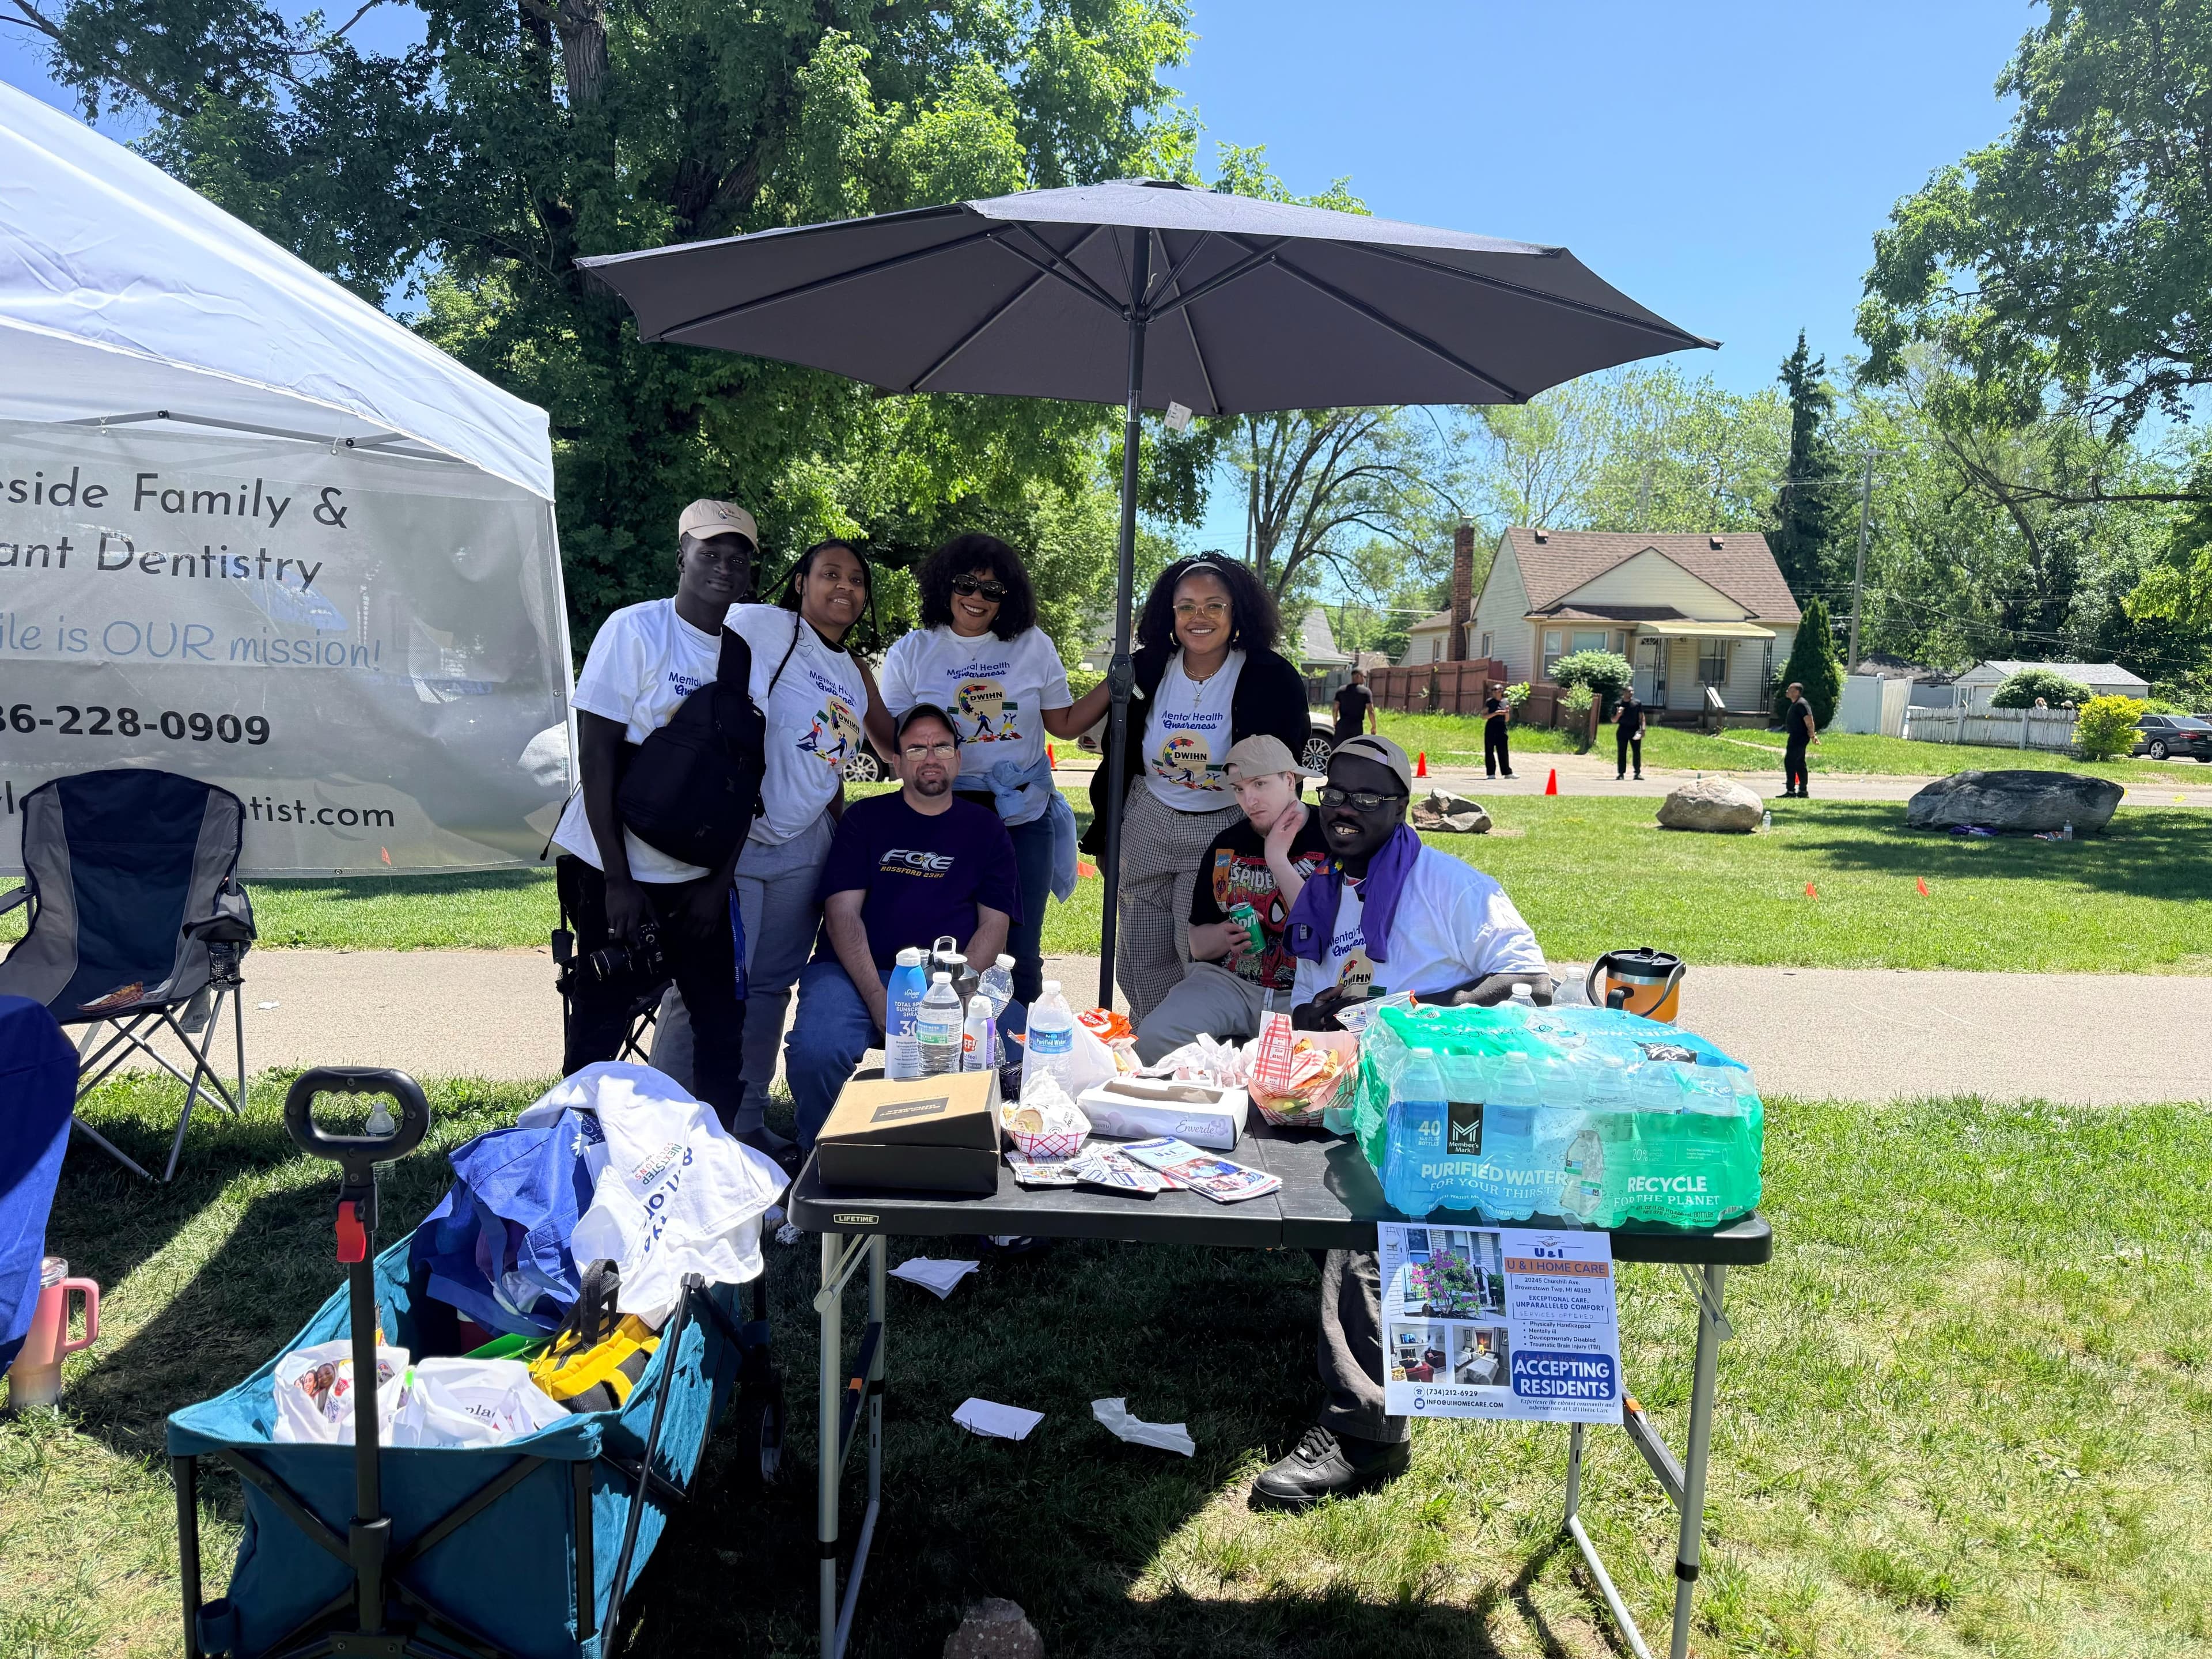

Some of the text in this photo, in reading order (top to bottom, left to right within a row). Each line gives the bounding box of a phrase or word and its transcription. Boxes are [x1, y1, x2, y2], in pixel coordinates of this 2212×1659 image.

[0, 467, 348, 528] side Family &
[97, 531, 323, 593] Dentistry
[58, 615, 88, 653] is
[103, 620, 215, 661] OUR
[230, 627, 381, 672] mission!
[980, 662, 1010, 671] Health
[970, 691, 1003, 702] DWIHN
[838, 713, 859, 733] DWIHN
[1193, 713, 1223, 721] Health
[1175, 752, 1207, 760] DWIHN
[880, 866, 922, 877] ROSSFORD
[904, 989, 920, 999] Kroger
[963, 1039, 976, 1051] FF!
[1176, 1119, 1214, 1134] Enverde
[1418, 1120, 1440, 1136] 40
[1632, 1149, 1649, 1162] 20%
[642, 1143, 683, 1185] NEXTSTEP
[1421, 1162, 1569, 1186] PURIFIED WATER
[1430, 1178, 1554, 1199] FOR YOUR THIRST
[1627, 1176, 1707, 1192] RECYCLE
[1668, 1195, 1719, 1206] PLANET
[1534, 1248, 1545, 1257] U
[1558, 1249, 1563, 1258] I
[1507, 1260, 1606, 1274] U & I HOME CARE
[1516, 1301, 1569, 1309] UNPARALLELED
[1513, 1359, 1610, 1378] ACCEPTING
[1426, 1388, 1478, 1397] (734)212-6929
[1520, 1378, 1610, 1397] RESIDENTS
[1426, 1399, 1504, 1408] INFO@UIHOMECARE.COM
